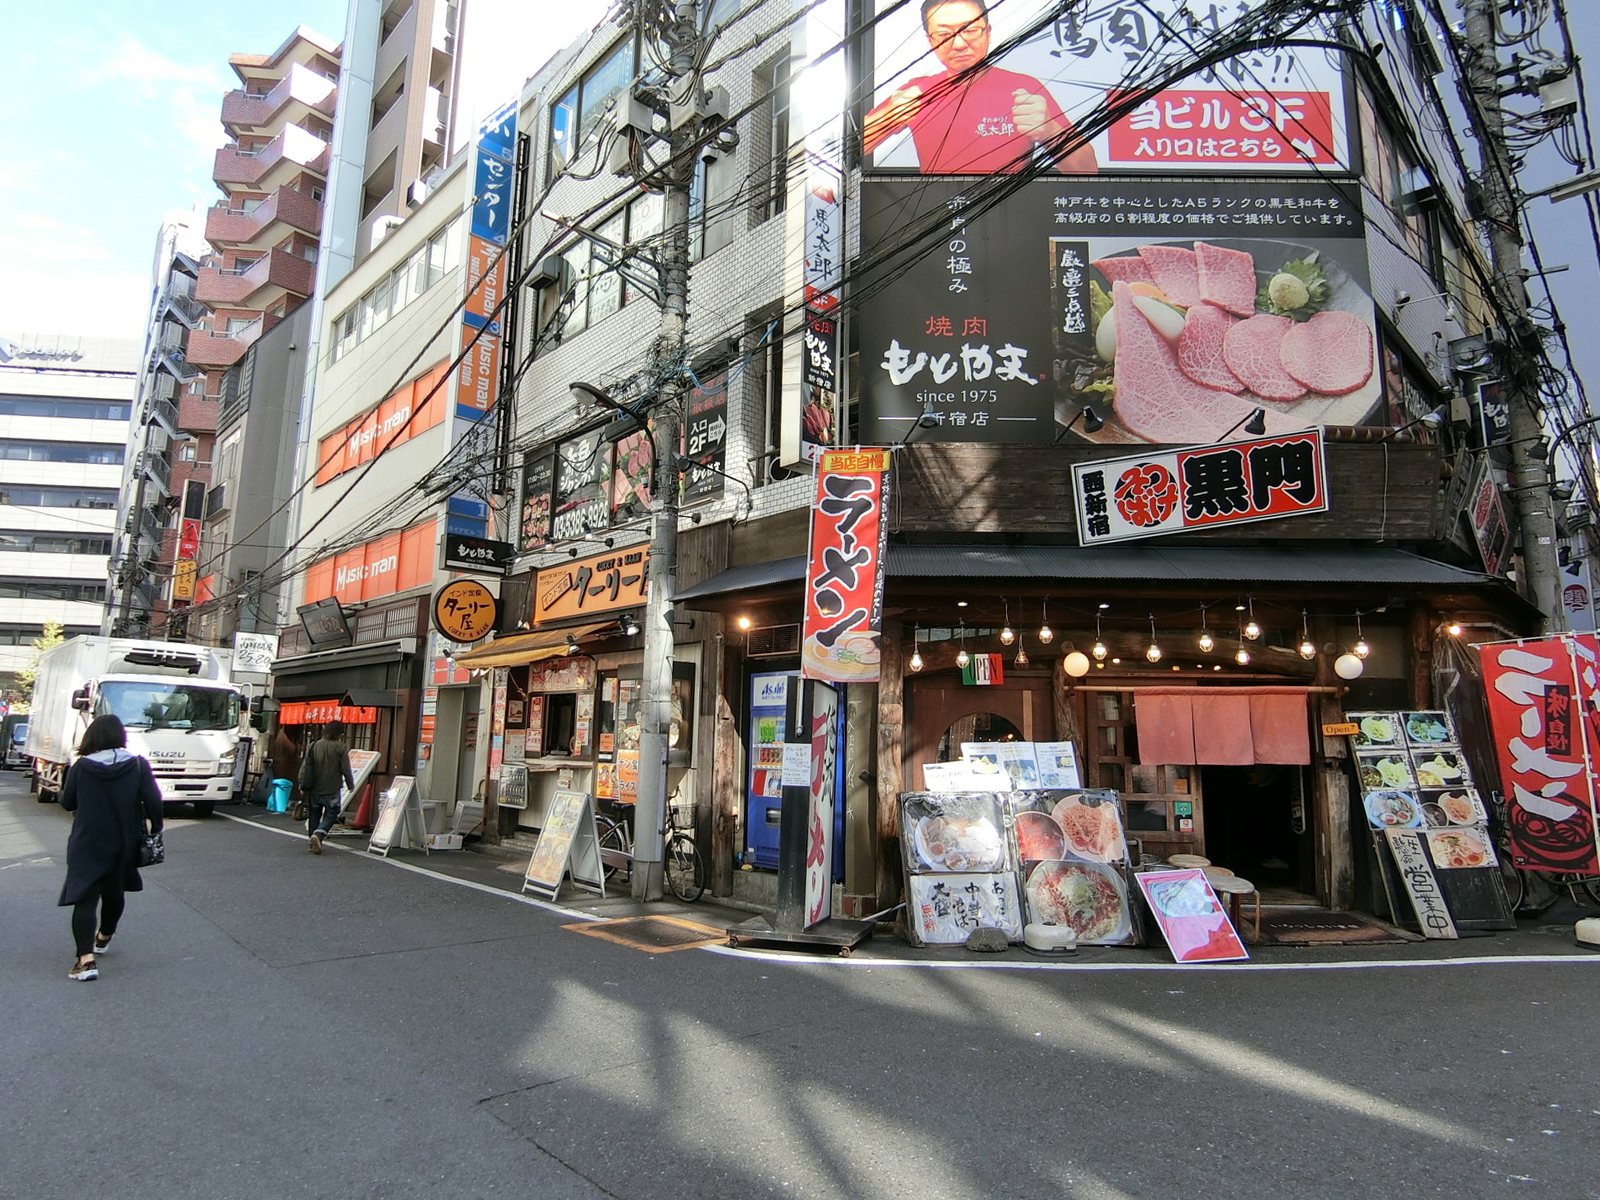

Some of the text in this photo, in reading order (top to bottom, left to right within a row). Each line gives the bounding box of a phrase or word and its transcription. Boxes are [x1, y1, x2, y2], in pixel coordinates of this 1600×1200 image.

[1129, 97, 1305, 132] 当ビル 3F
[975, 123, 1015, 137] 馬太郎
[1133, 138, 1282, 158] 入り口はこちら
[810, 208, 832, 282] 馬太郎
[926, 316, 988, 337] 焼肉
[475, 331, 496, 409] Music man
[880, 339, 1038, 386] もとやま
[916, 390, 997, 403] since 1975
[350, 405, 410, 457] Music man
[691, 419, 708, 435] 入口
[690, 432, 708, 455] 2F
[830, 454, 884, 472] 当店自慢
[1184, 439, 1317, 520] 黒門
[1081, 470, 1111, 537] 西新宿
[336, 554, 397, 592] Music man
[812, 474, 876, 649] ラーメン
[443, 597, 490, 617] ターリー
[460, 613, 475, 631] 屋
[968, 657, 998, 681] OPEN
[761, 682, 785, 696] Asahi
[1325, 725, 1351, 735] Open
[932, 882, 950, 917] 大盛
[922, 904, 935, 932] 無料
